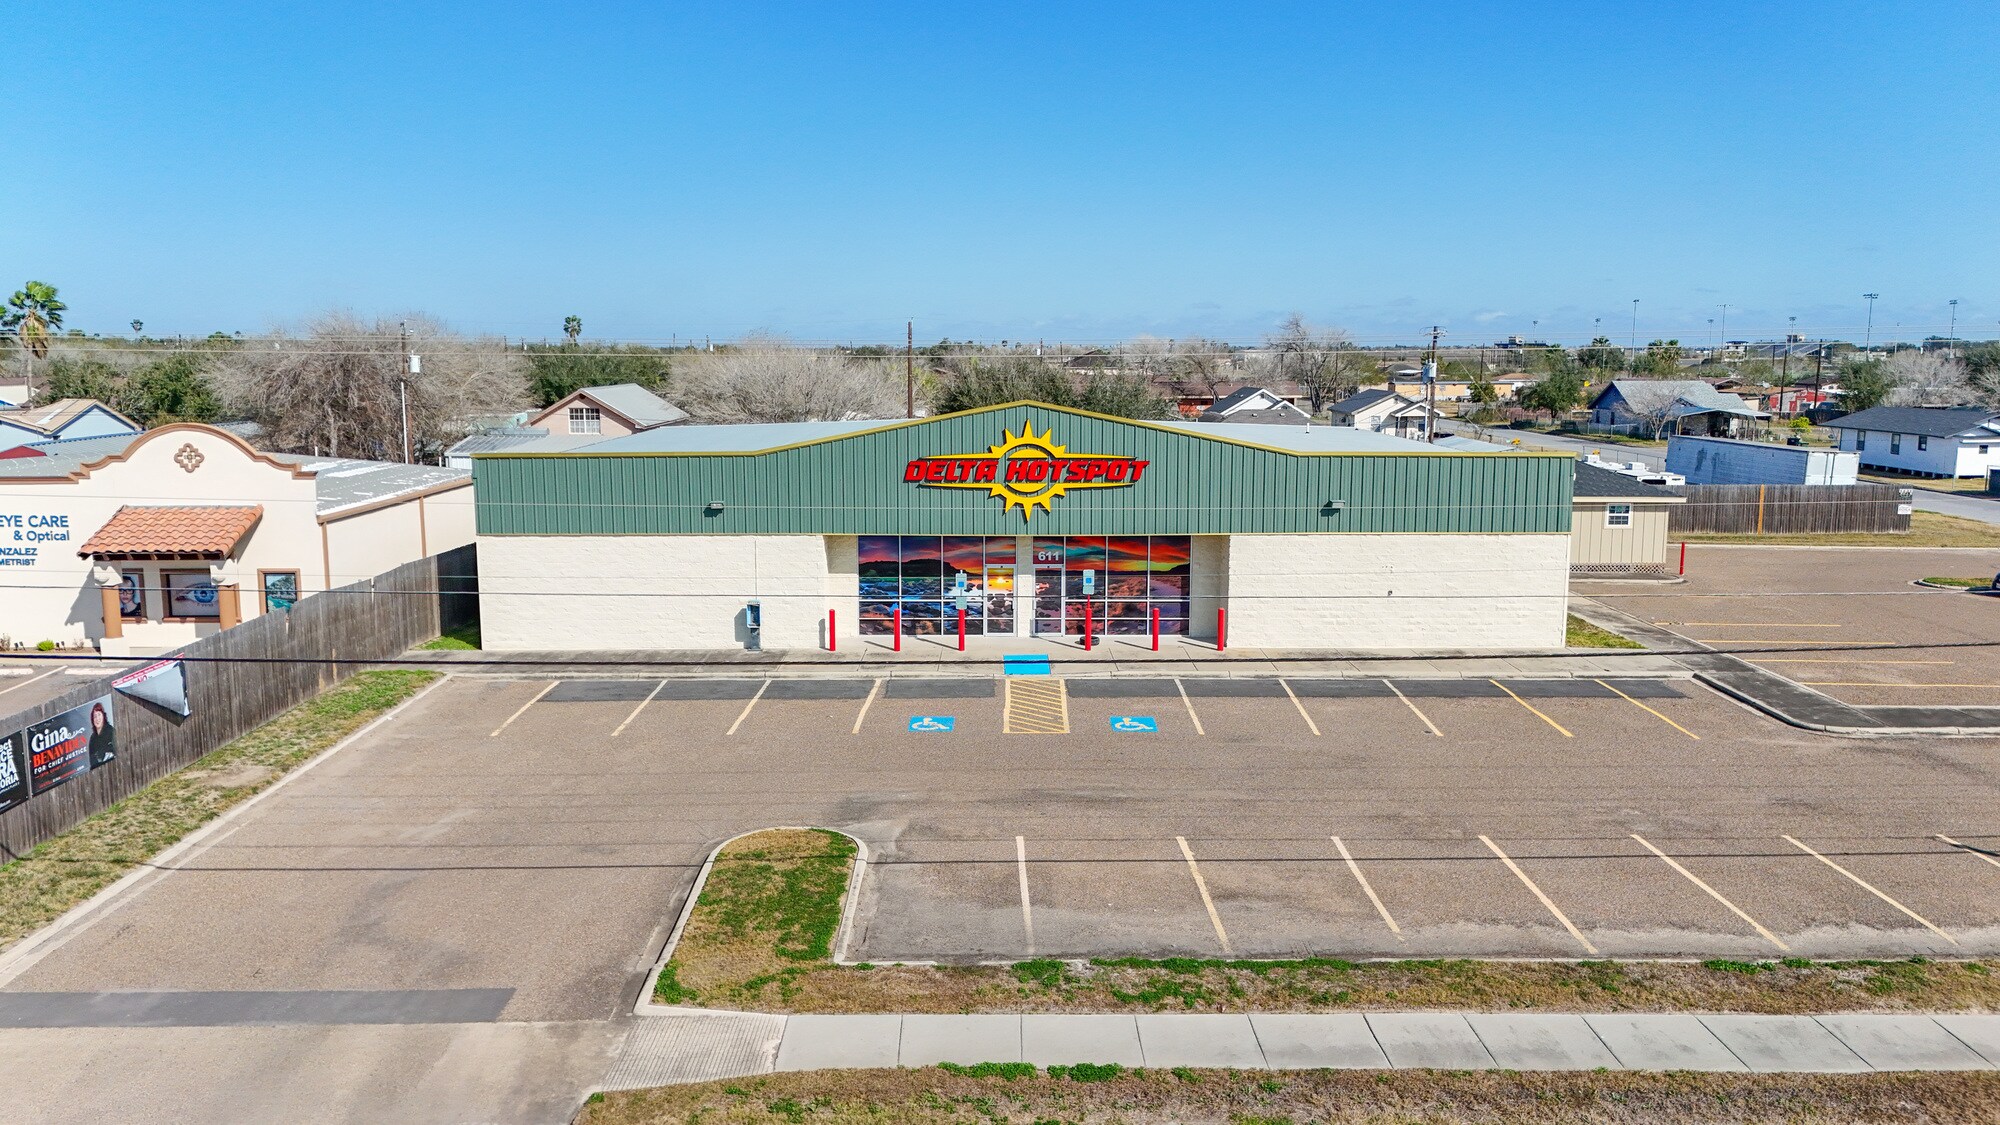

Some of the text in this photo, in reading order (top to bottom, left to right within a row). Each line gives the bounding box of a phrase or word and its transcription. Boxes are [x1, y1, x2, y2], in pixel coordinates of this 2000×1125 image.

[904, 458, 1150, 482] DELTA HOTSPOT
[28, 515, 69, 528] CARE
[13, 530, 70, 544] & Optical
[1038, 551, 1059, 561] 611
[31, 726, 68, 753] Gina
[34, 764, 47, 775] FOR
[48, 756, 64, 769] CHIEF
[65, 746, 87, 761] JUSTICE
